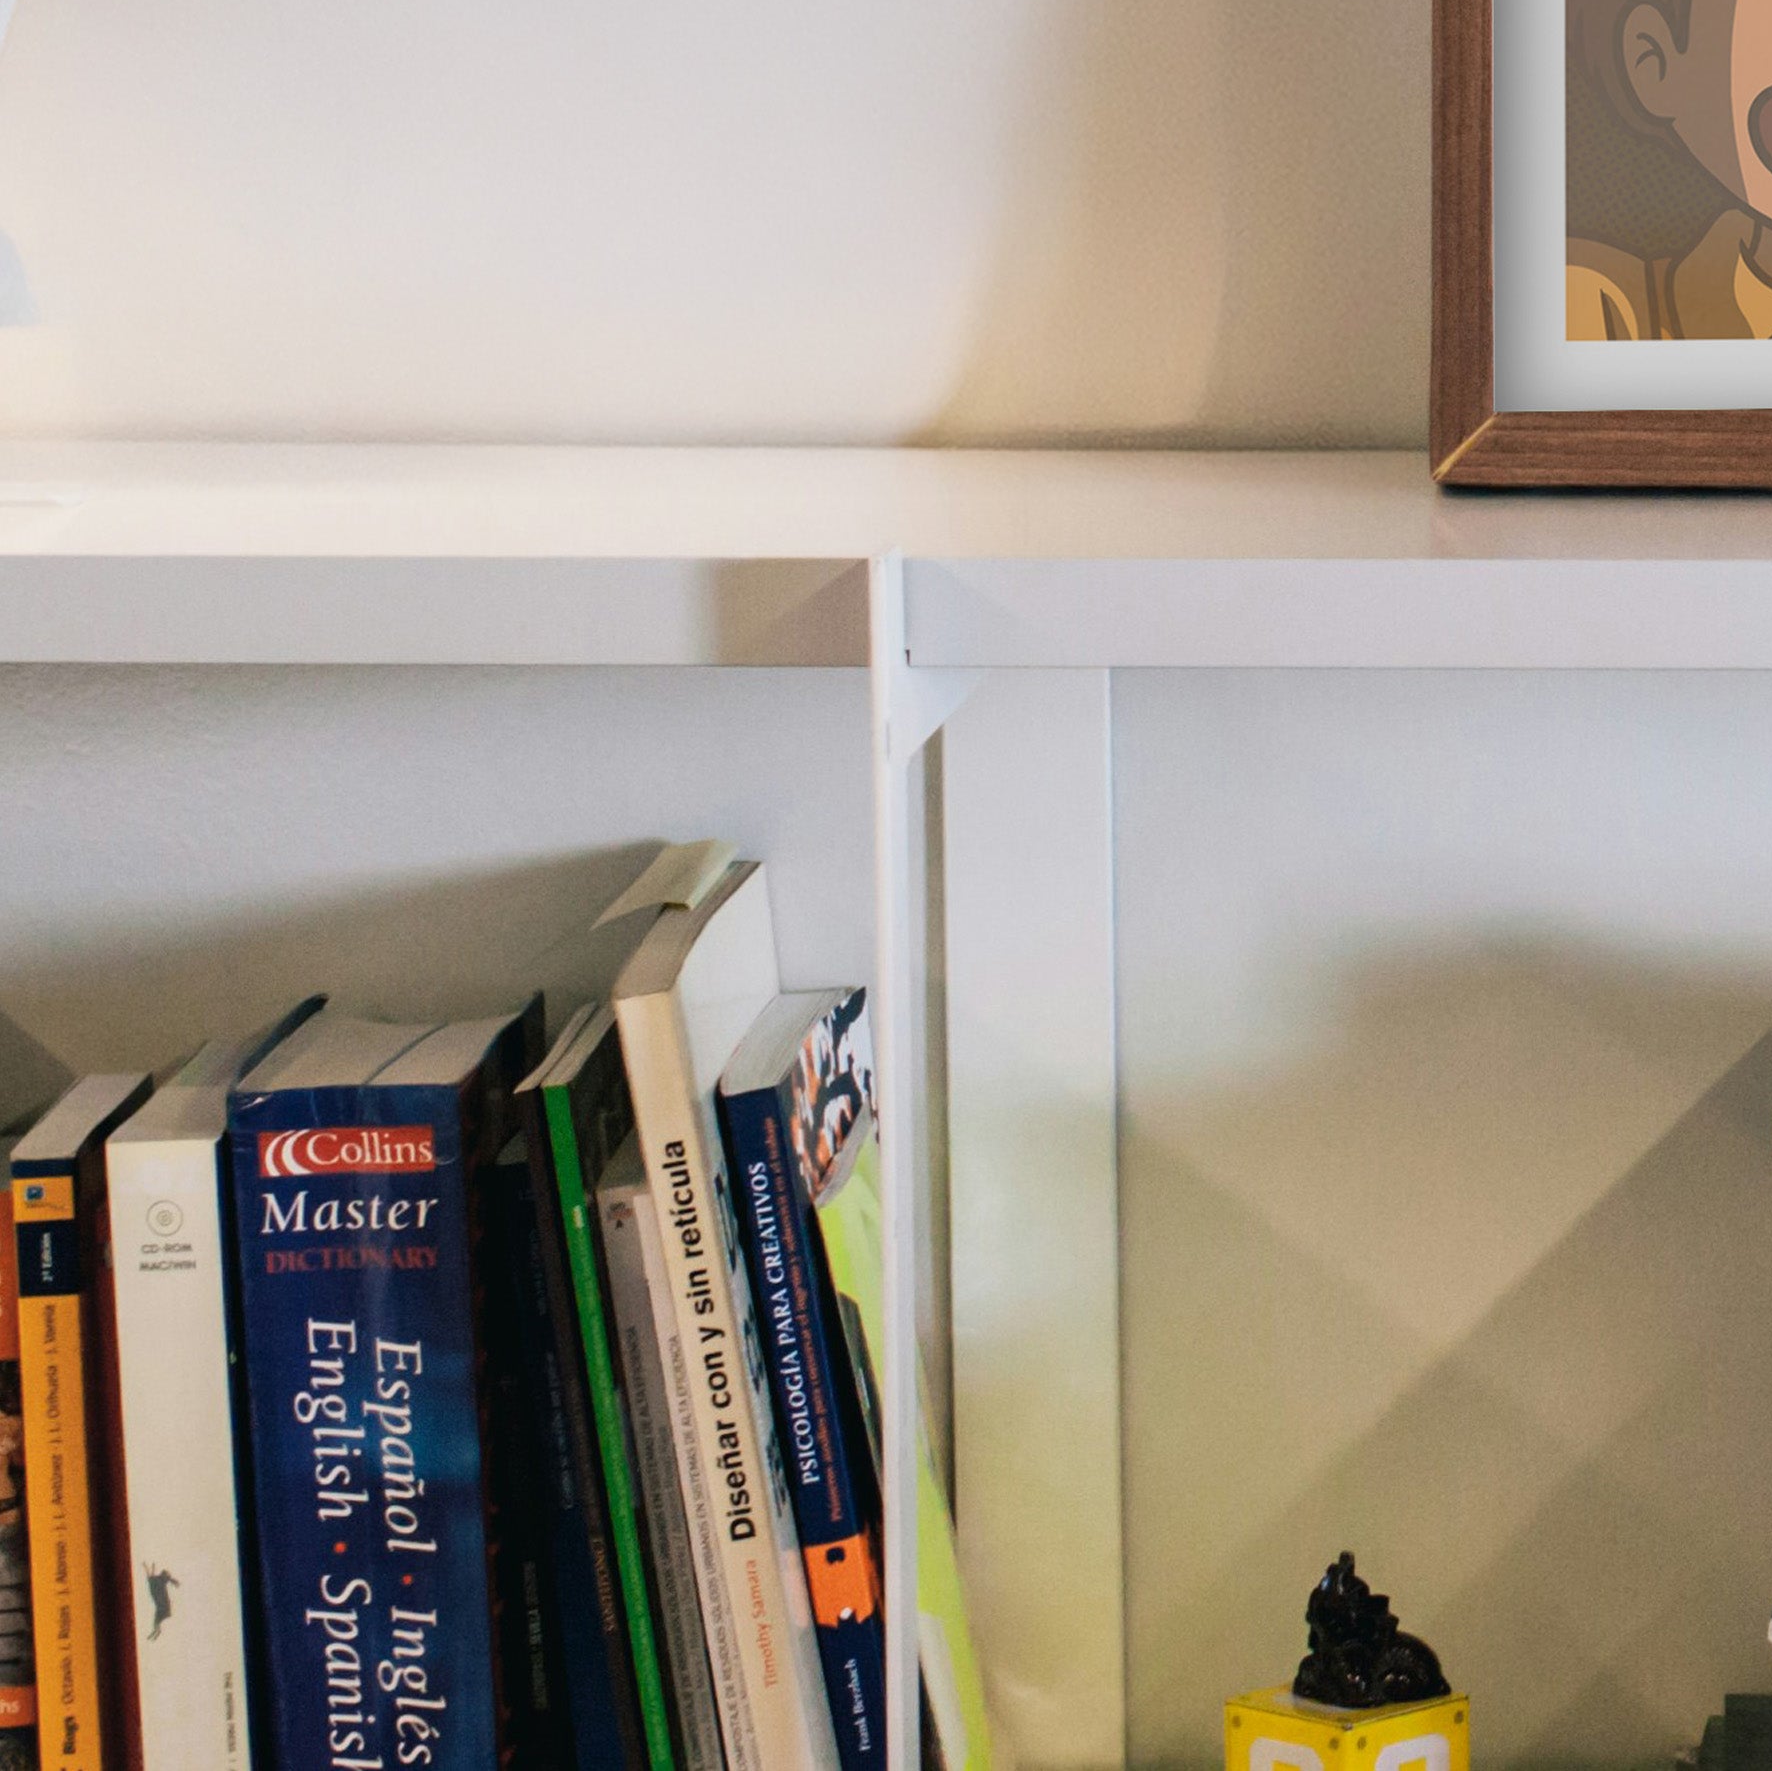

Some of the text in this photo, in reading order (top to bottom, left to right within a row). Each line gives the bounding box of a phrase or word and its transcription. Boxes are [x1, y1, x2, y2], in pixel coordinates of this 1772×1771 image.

[261, 1192, 438, 1234] Master
[306, 1132, 434, 1168] Collins
[265, 1246, 438, 1274] DICTIONARY
[748, 1160, 820, 1484] PSICOLOGÍA PARA CREATIVOS
[661, 1139, 757, 1542] Diseñar con y sin retícula
[294, 1317, 370, 1522] English
[364, 1336, 447, 1765] Español Inglés
[744, 1559, 779, 1689] Timothy Samara
[853, 1716, 872, 1751] Frank
